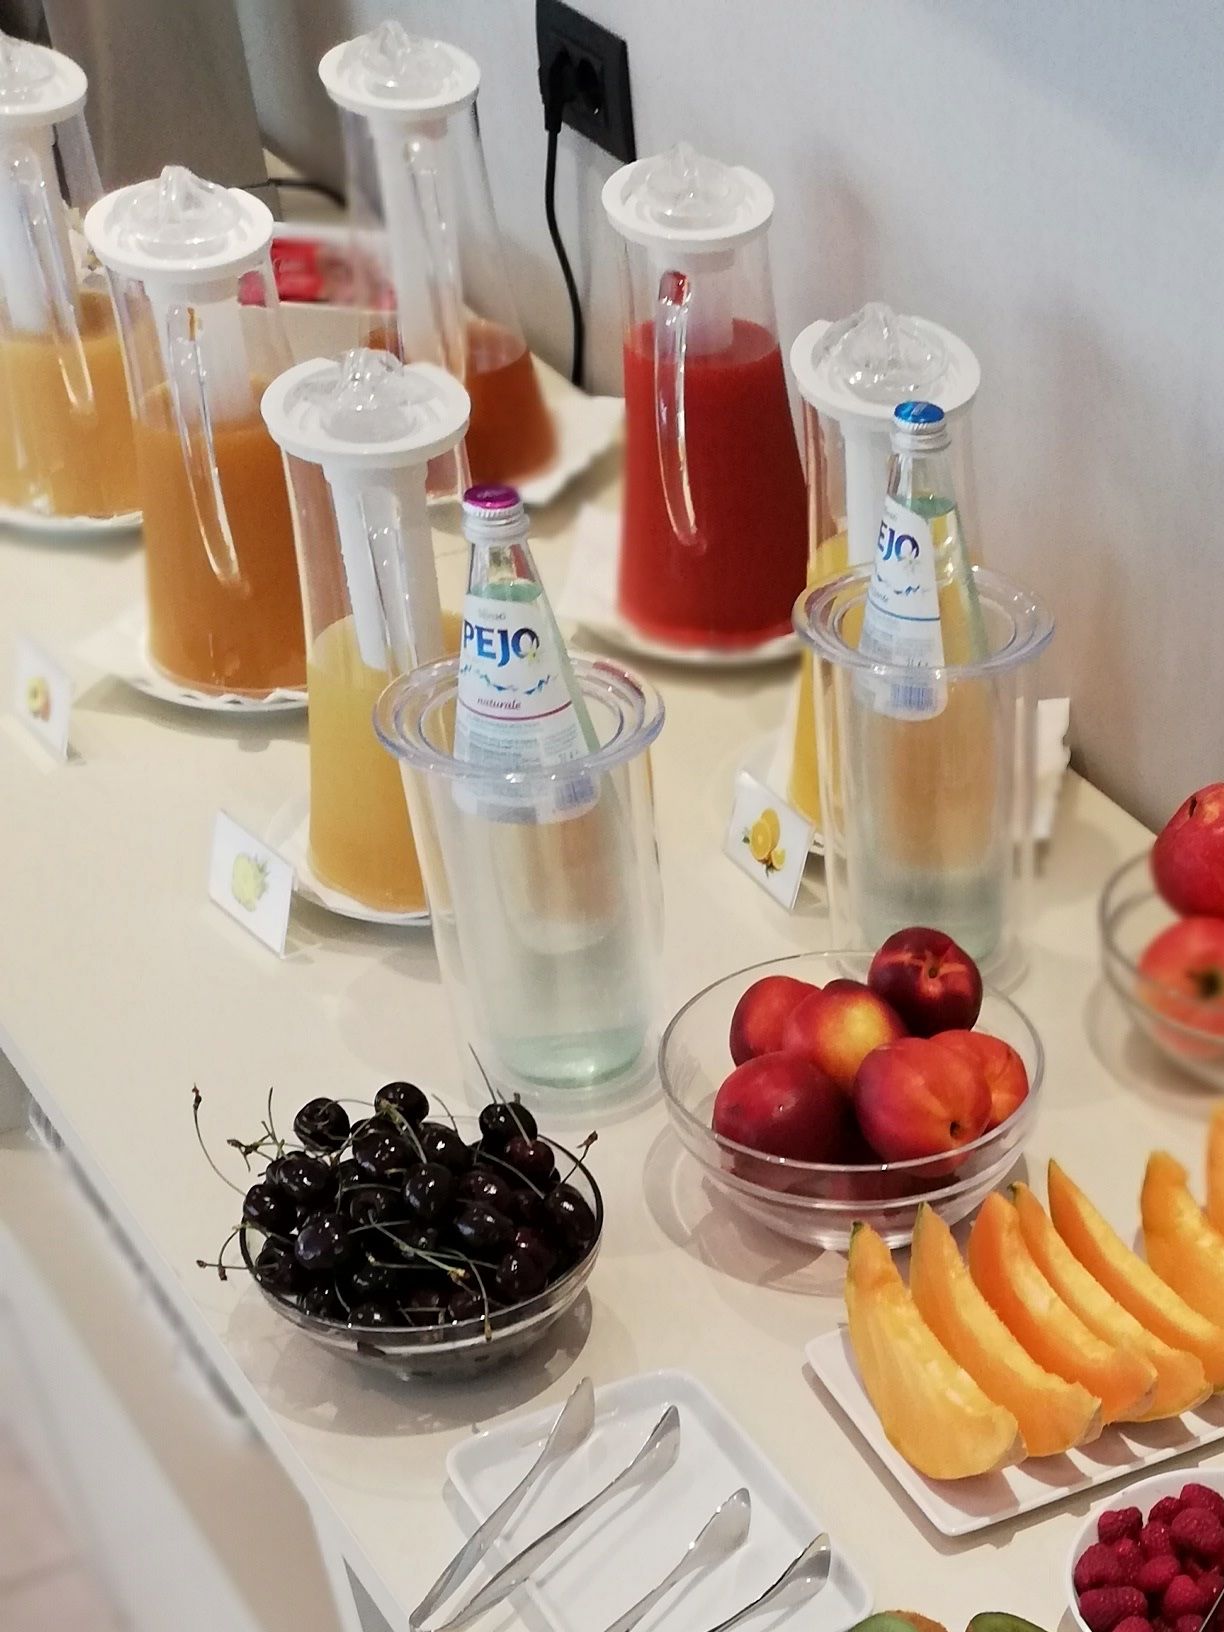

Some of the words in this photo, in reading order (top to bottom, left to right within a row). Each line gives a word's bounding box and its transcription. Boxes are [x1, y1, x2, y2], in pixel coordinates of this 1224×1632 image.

[877, 519, 920, 561] EJO
[463, 619, 540, 668] PEJO
[477, 697, 522, 711] naturale
